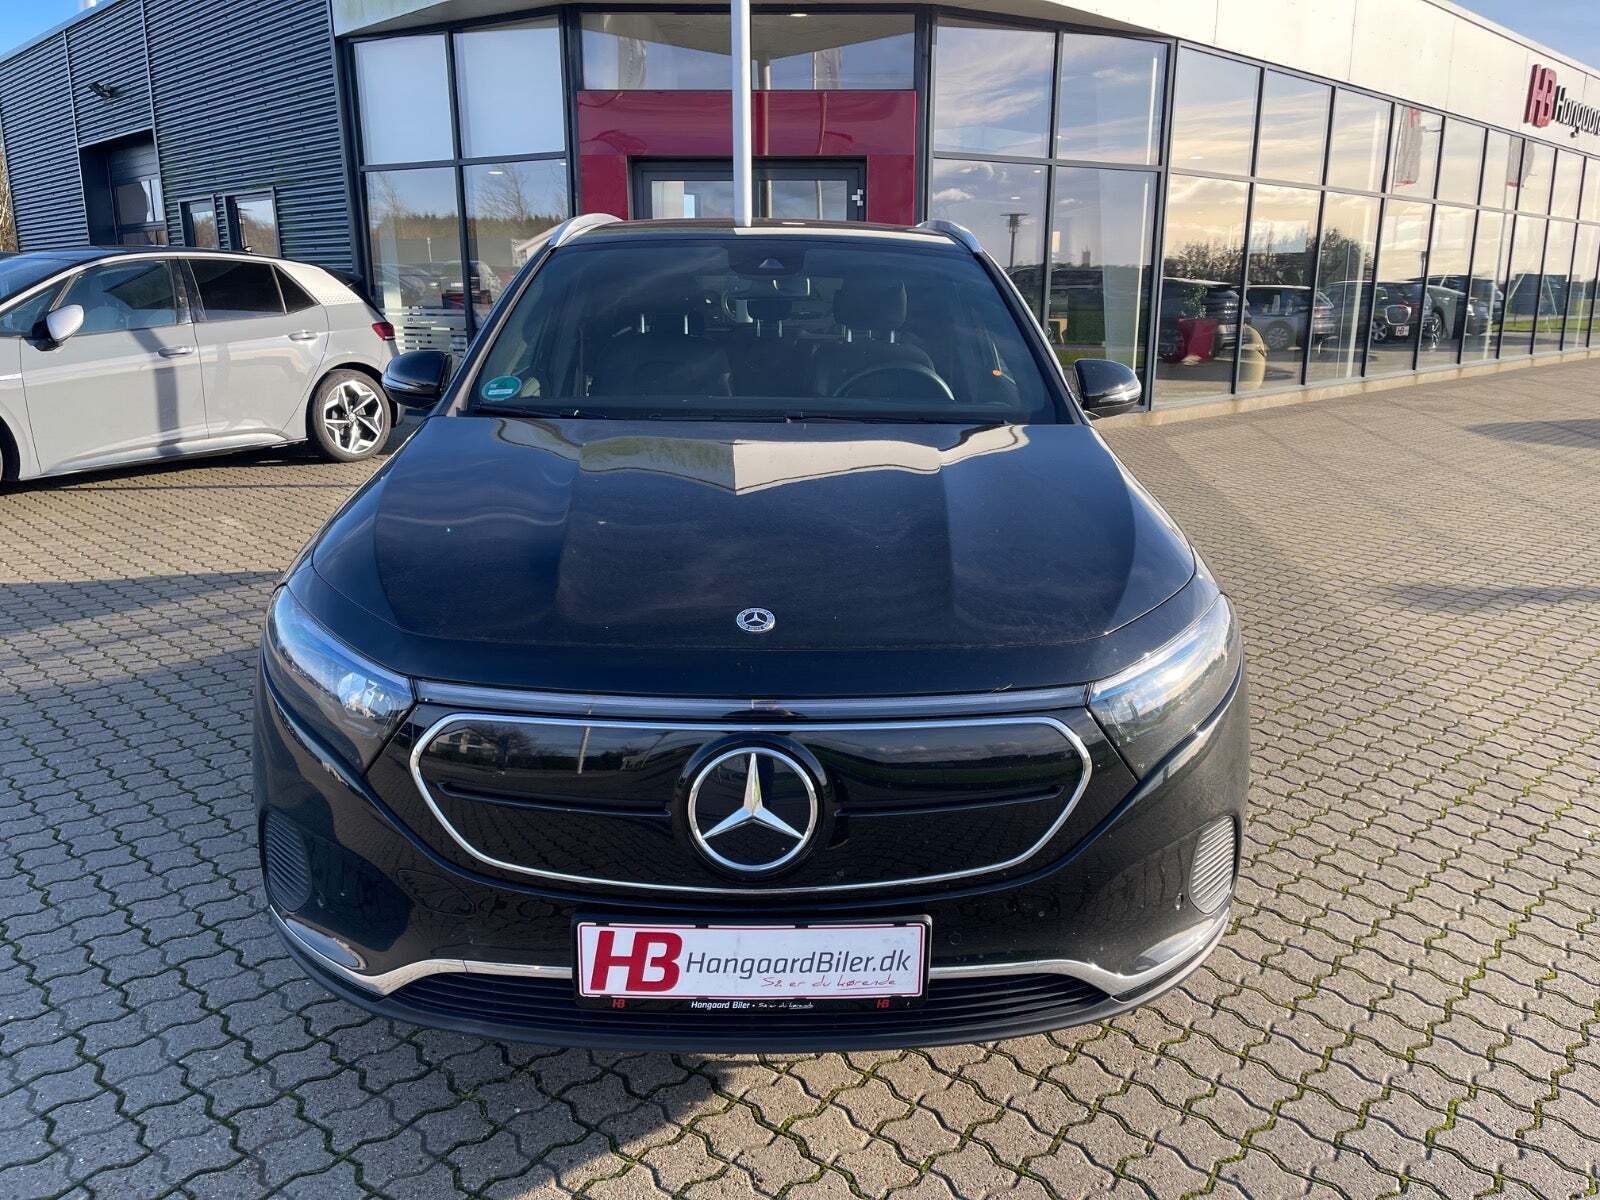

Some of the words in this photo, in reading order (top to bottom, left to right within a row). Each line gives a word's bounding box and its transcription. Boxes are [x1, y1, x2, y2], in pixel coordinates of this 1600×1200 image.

[1523, 63, 1557, 128] HB
[590, 930, 683, 992] HB
[686, 949, 911, 979] HangaardBiler.dk
